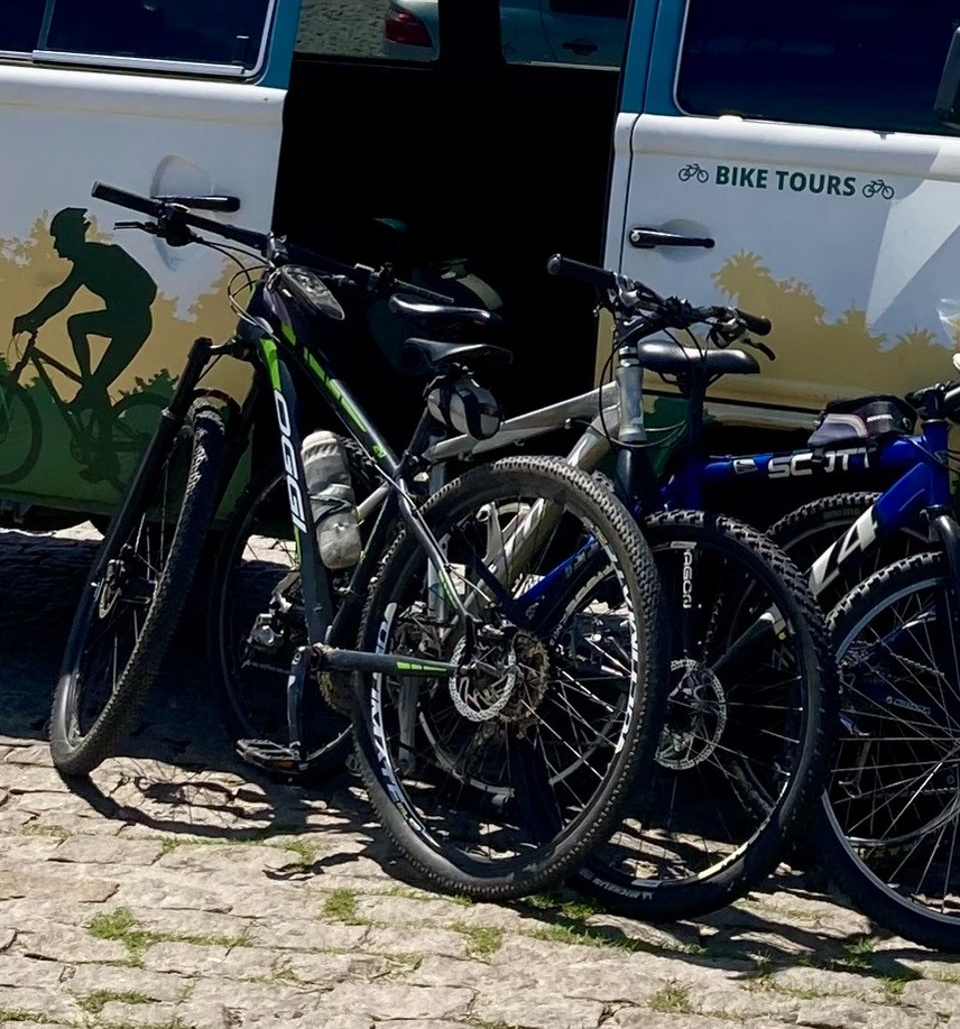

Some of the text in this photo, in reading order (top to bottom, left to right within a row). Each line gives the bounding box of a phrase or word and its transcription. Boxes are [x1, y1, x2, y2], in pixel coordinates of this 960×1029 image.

[715, 165, 856, 197] BIKE TOURS
[274, 390, 307, 533] OGGI
